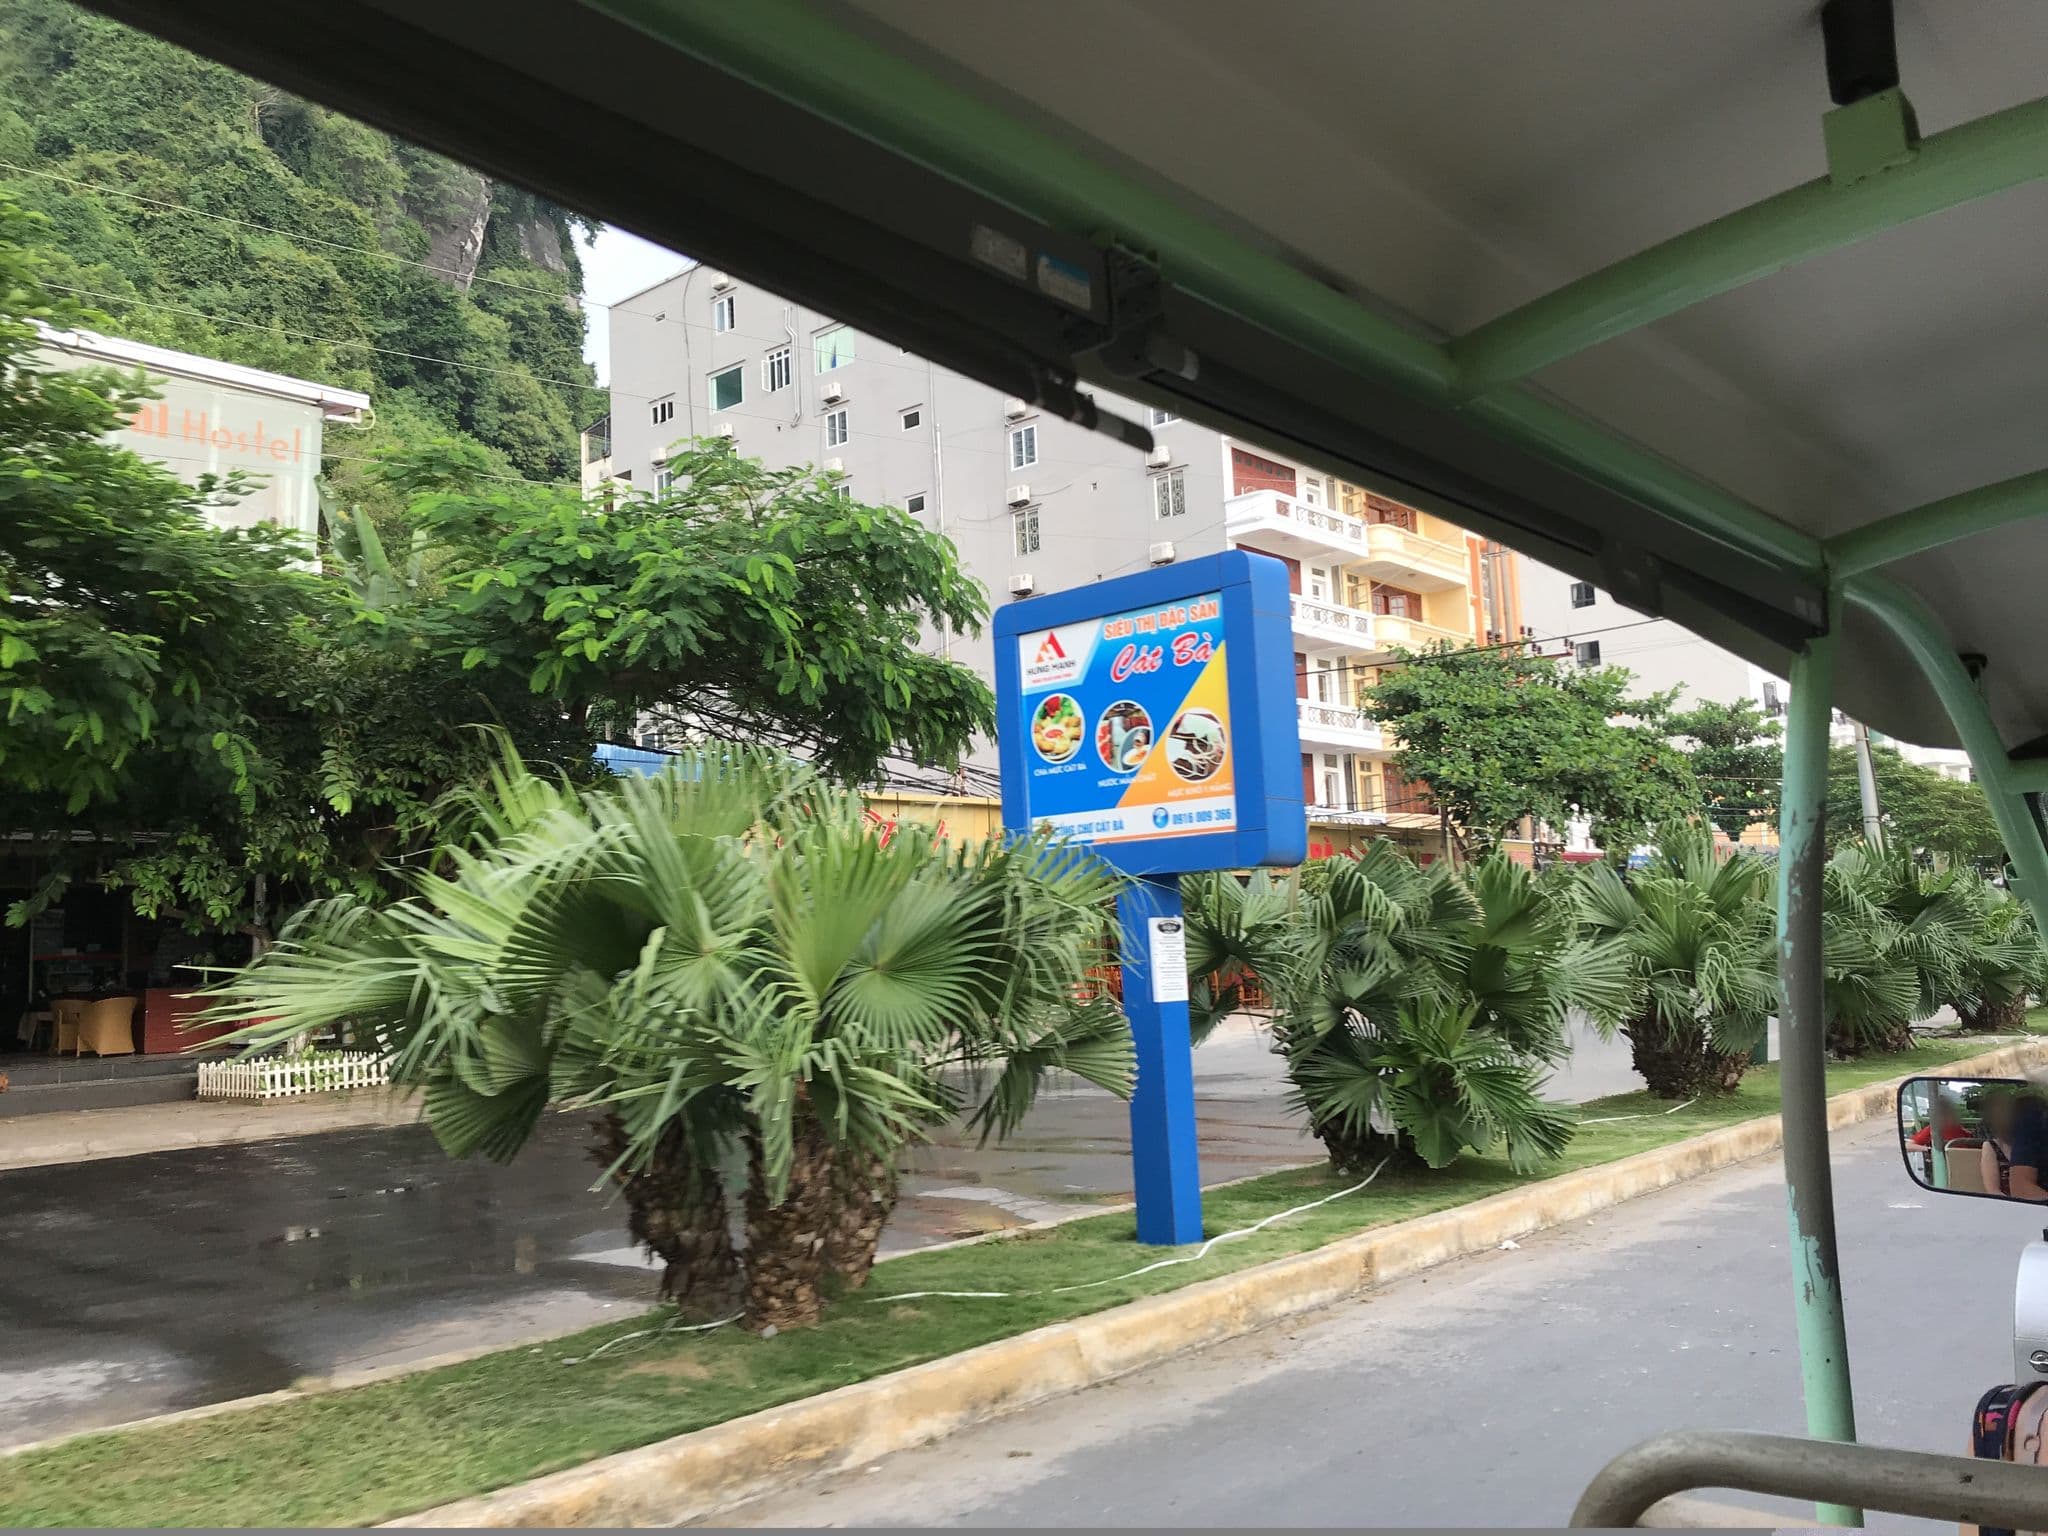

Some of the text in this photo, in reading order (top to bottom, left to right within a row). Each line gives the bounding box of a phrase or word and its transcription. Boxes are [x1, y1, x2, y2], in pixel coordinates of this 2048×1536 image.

[182, 408, 303, 463] Hostel
[1104, 617, 1134, 640] SIÊU
[1136, 613, 1157, 635] THỊ
[1110, 631, 1213, 683] Cát Bà
